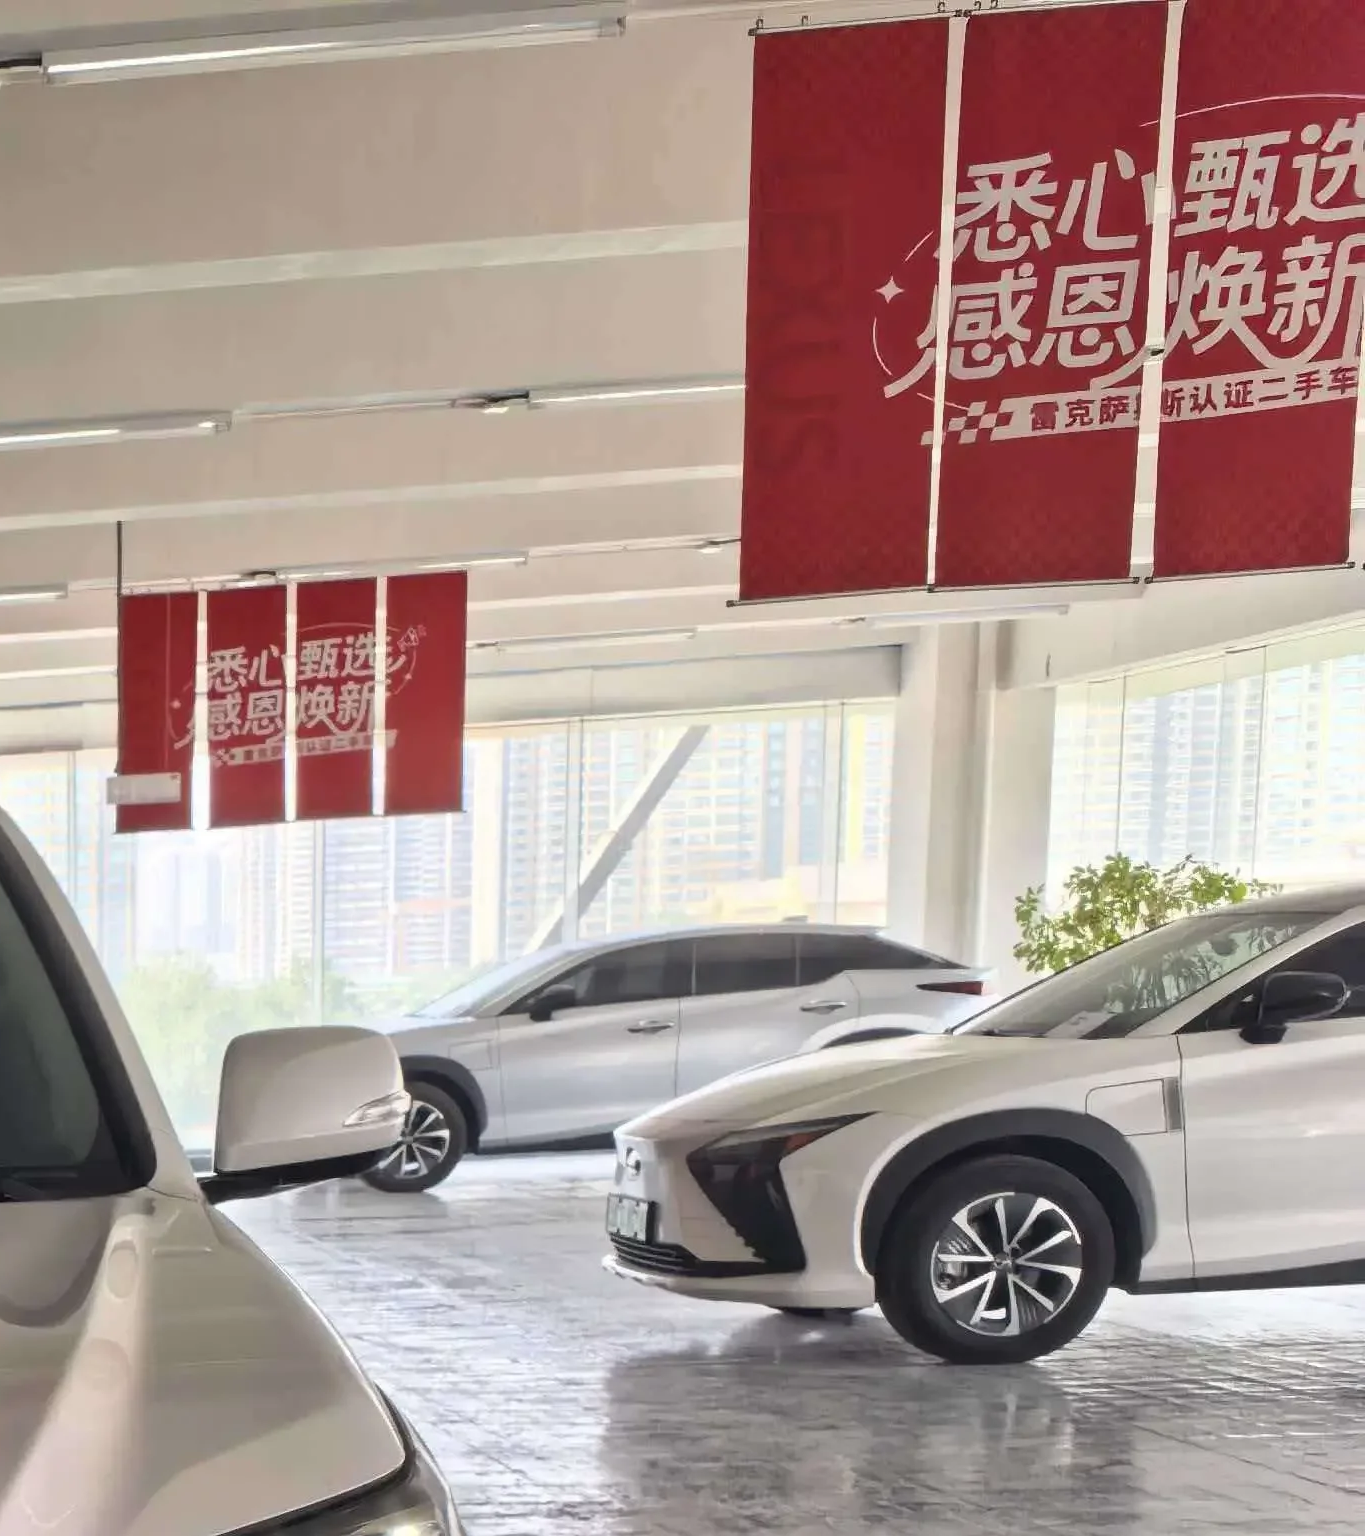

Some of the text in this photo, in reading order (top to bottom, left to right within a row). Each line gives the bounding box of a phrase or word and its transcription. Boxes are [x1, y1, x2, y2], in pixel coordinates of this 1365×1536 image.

[935, 112, 1365, 263] 悉心甄选
[883, 233, 1365, 398] 感恩焕新
[174, 680, 391, 749] 感恩焕新
[207, 631, 406, 692] 悉心甄选
